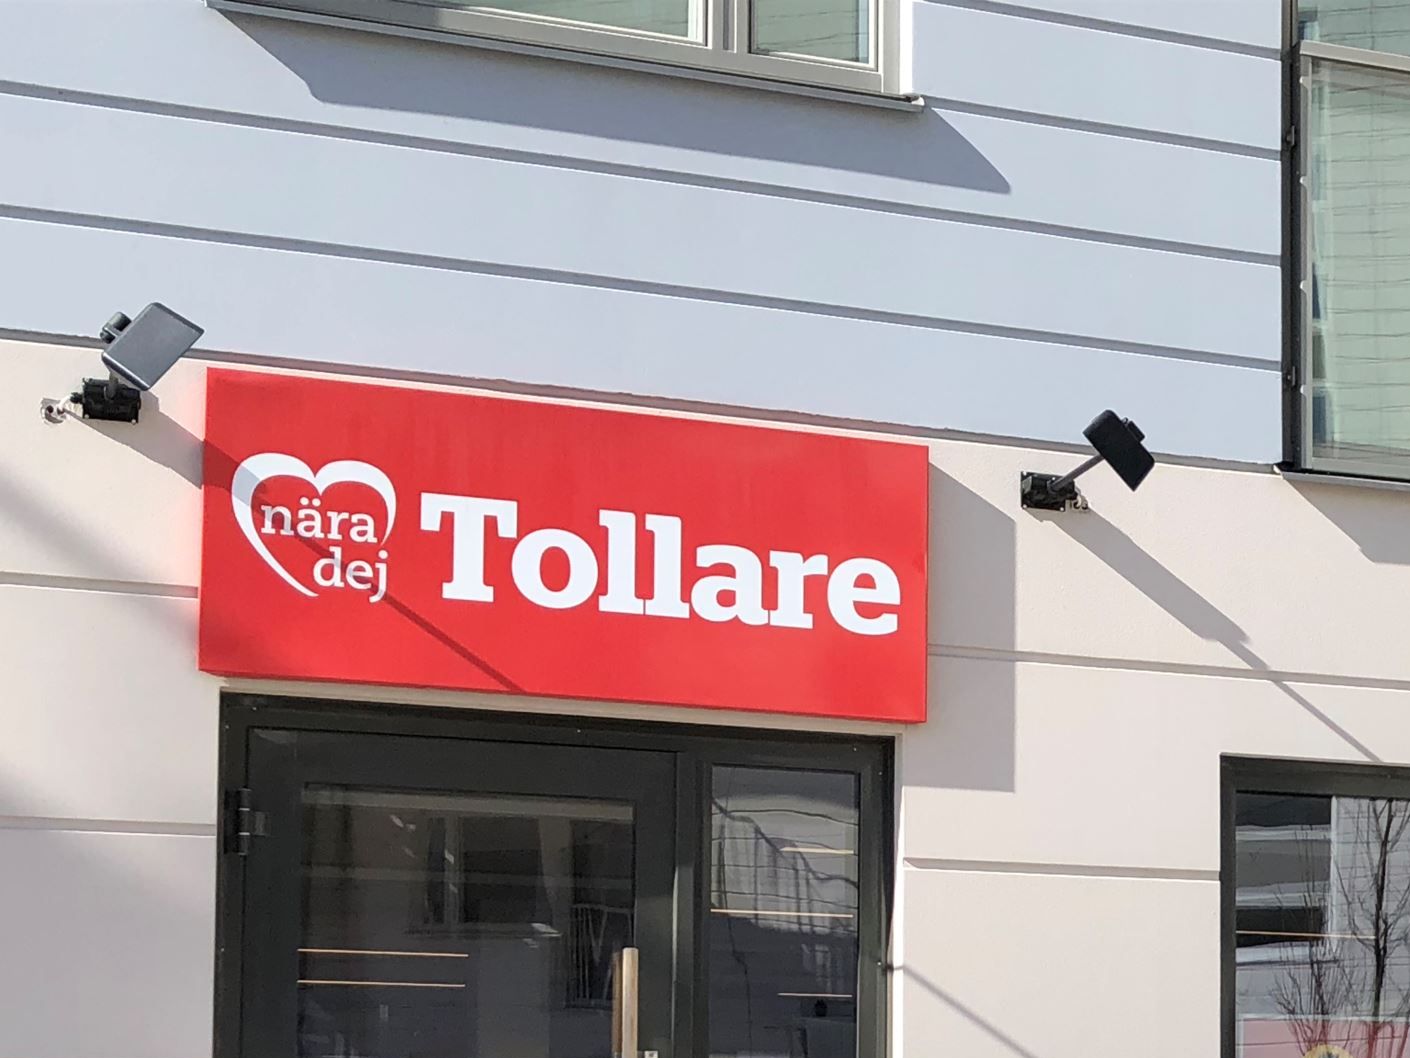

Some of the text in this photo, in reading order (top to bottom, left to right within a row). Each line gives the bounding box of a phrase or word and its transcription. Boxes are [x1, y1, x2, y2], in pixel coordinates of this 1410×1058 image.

[260, 496, 378, 545] nära
[313, 543, 389, 604] dej
[420, 491, 902, 637] Tollare
